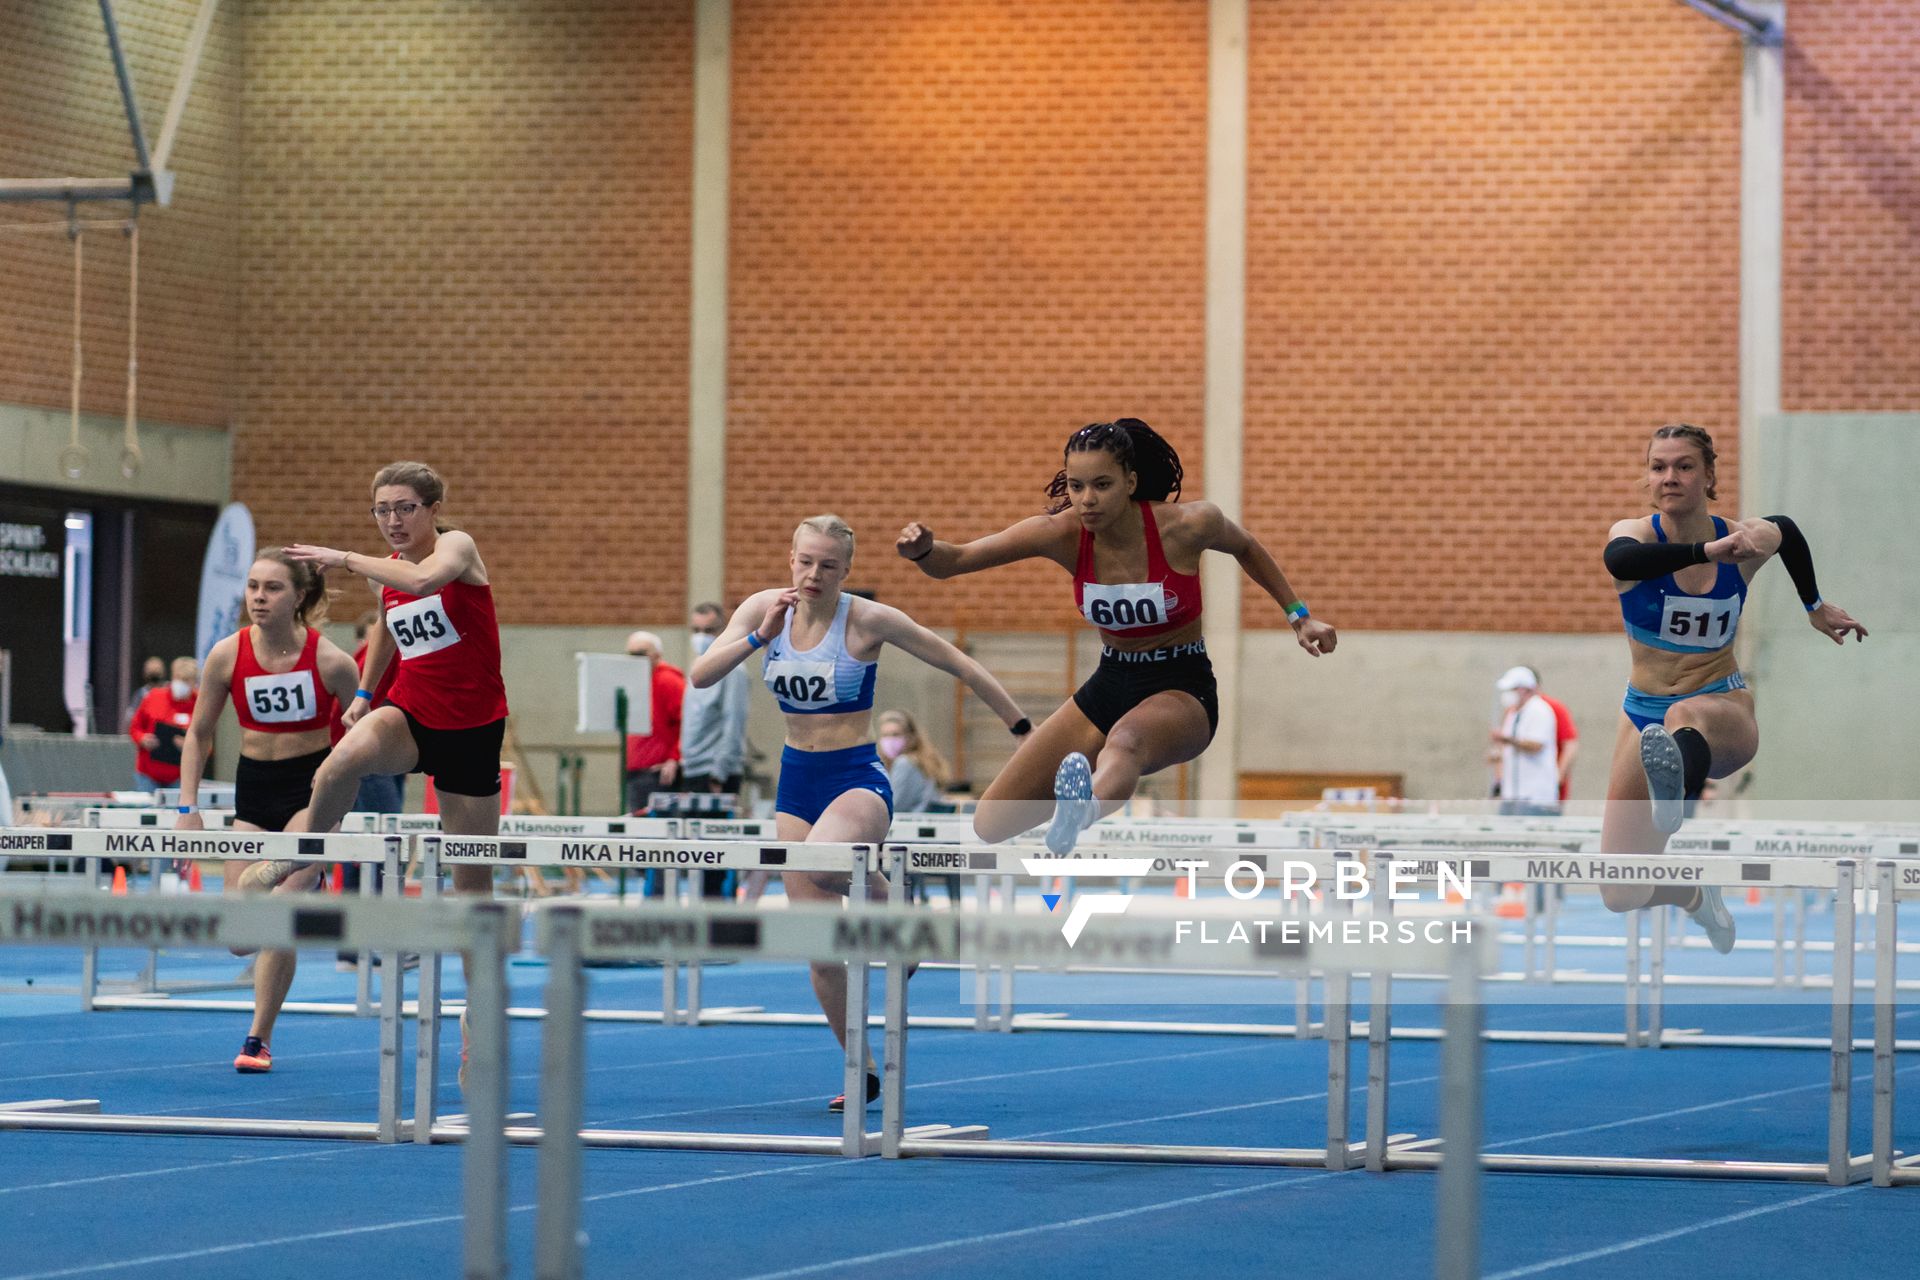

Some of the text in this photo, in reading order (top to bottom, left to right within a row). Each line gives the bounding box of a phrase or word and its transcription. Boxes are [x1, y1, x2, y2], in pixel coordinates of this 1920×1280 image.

[1091, 599, 1158, 625] 600
[1669, 611, 1730, 637] 511
[393, 610, 445, 647] 543
[253, 684, 305, 714] 531
[773, 675, 828, 701] 402
[106, 835, 155, 853] MKA
[162, 835, 264, 856] Hannover
[1100, 831, 1213, 843] MKA Hannover
[1755, 840, 1793, 852] MKA
[1797, 841, 1874, 854] Hannover
[561, 843, 612, 861] MKA
[619, 844, 725, 864] Hannover
[1527, 861, 1582, 879] MKA
[1590, 861, 1704, 881] Hannover
[13, 903, 220, 938] Hannover
[833, 917, 940, 949] MKA
